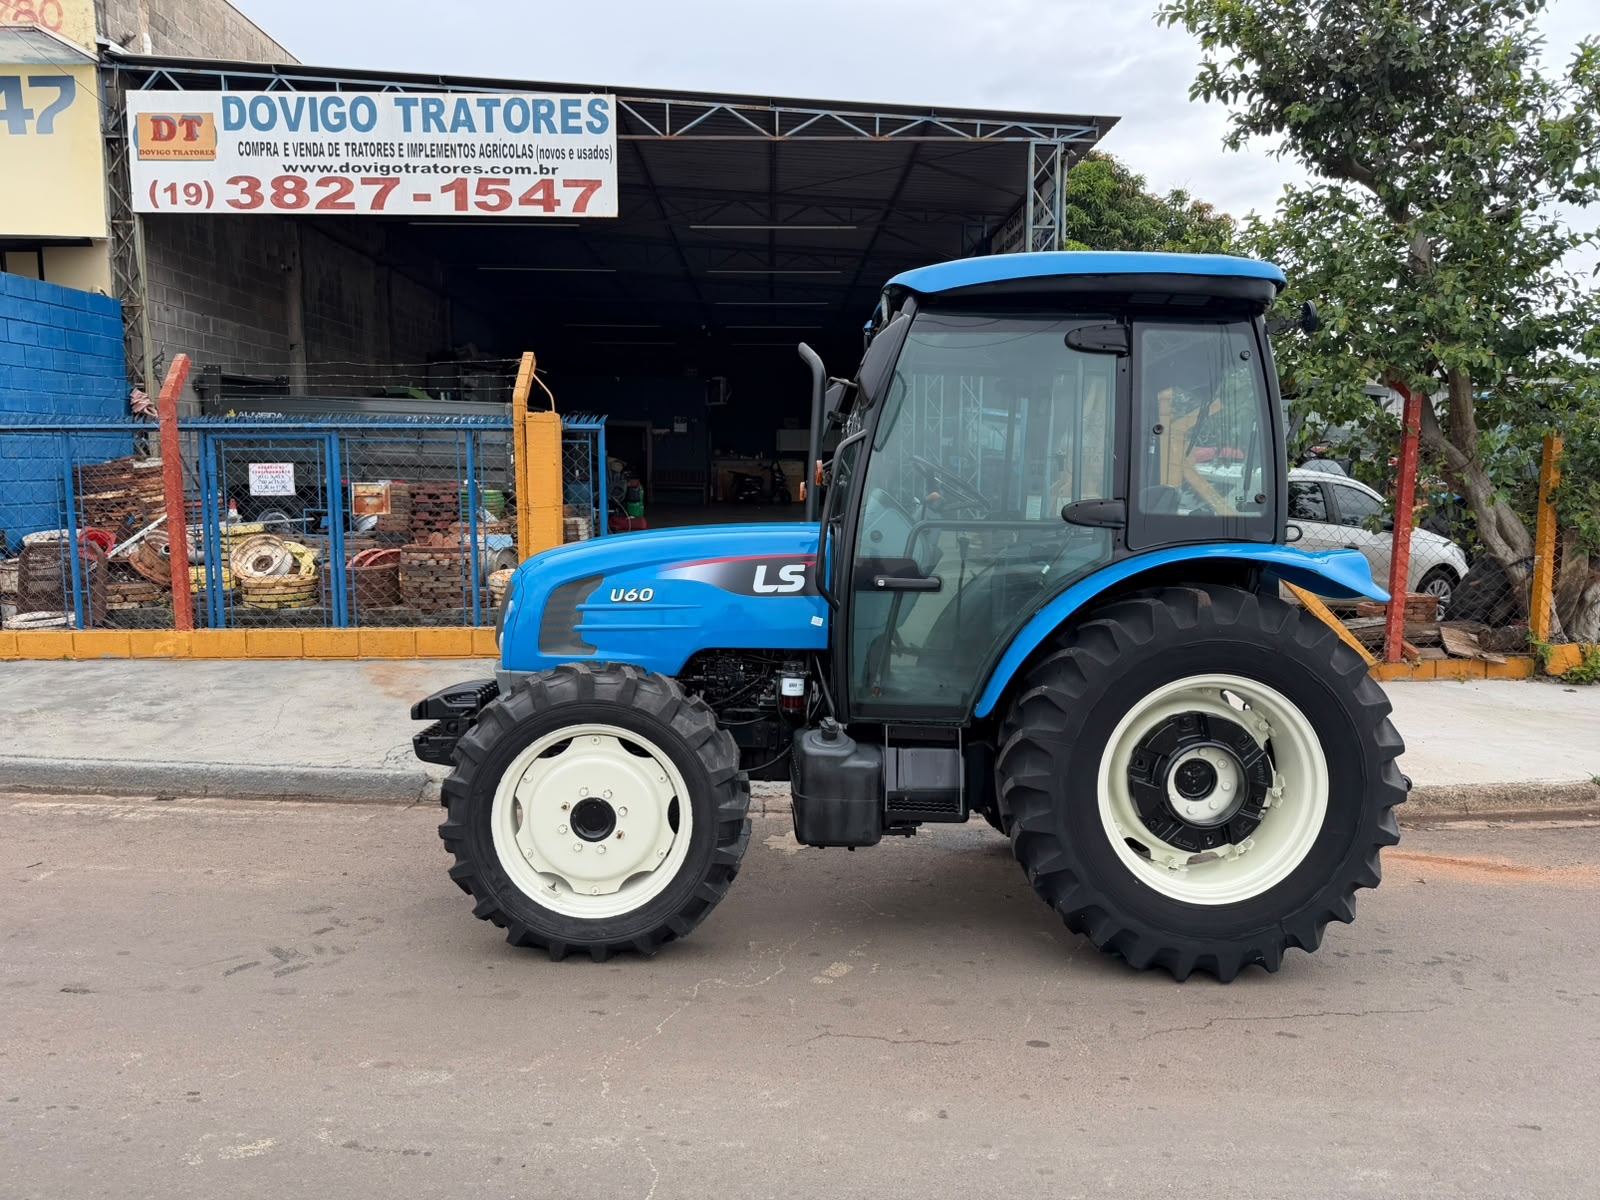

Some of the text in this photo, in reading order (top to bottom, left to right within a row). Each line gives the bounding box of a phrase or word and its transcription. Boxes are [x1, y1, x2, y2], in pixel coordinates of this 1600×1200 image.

[150, 115, 203, 142] DT
[222, 95, 610, 135] DOVIGO TRATORES
[237, 138, 613, 164] COMPRA E VENDA DE TRATORES E IMPLEMENTOS AGRÍCOLAS (novos e usados)
[282, 161, 560, 176] www.dovigotratores.com.br
[149, 174, 603, 213] (19) 3827-1547
[752, 564, 807, 593] LS
[610, 588, 655, 603] U60
